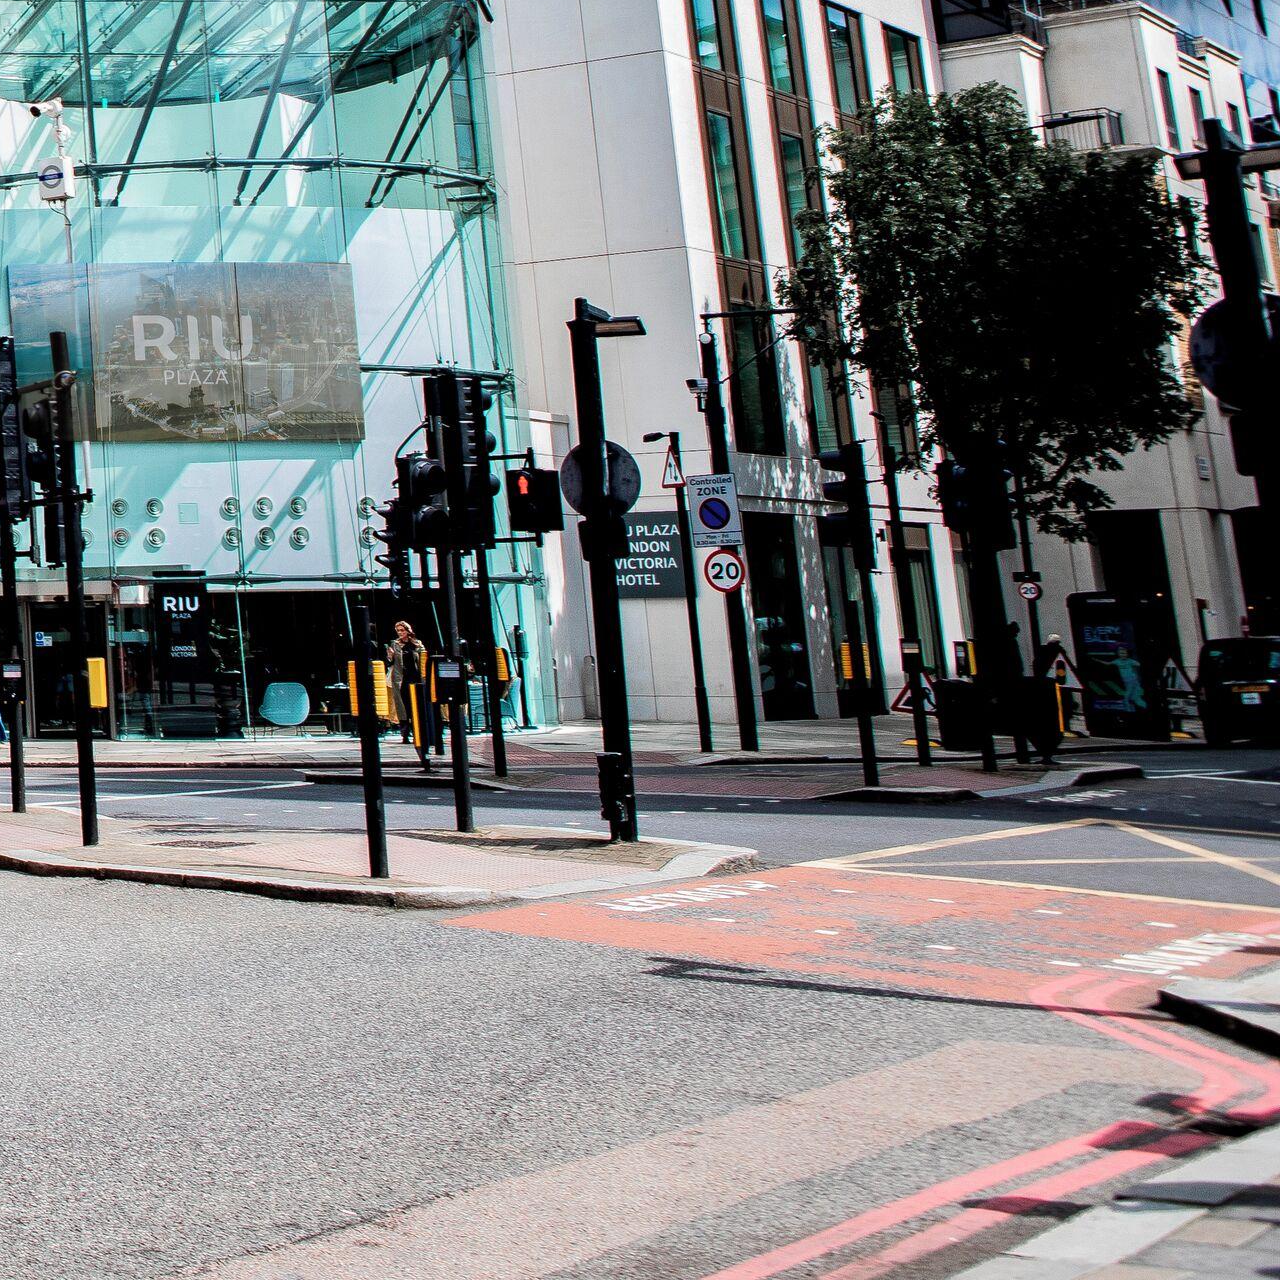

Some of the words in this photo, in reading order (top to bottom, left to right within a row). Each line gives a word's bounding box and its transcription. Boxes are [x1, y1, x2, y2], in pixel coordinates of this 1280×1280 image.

[132, 314, 253, 362] RIU
[163, 369, 229, 385] PLAZA
[690, 477, 732, 486] Controlled
[697, 486, 727, 496] ZONE
[636, 524, 680, 537] PLAZA
[629, 541, 671, 553] NDON
[614, 557, 678, 570] VICTORIA
[711, 562, 740, 580] 20
[616, 574, 661, 586] HOTEL
[1021, 586, 1037, 595] 20
[163, 596, 200, 612] RIU
